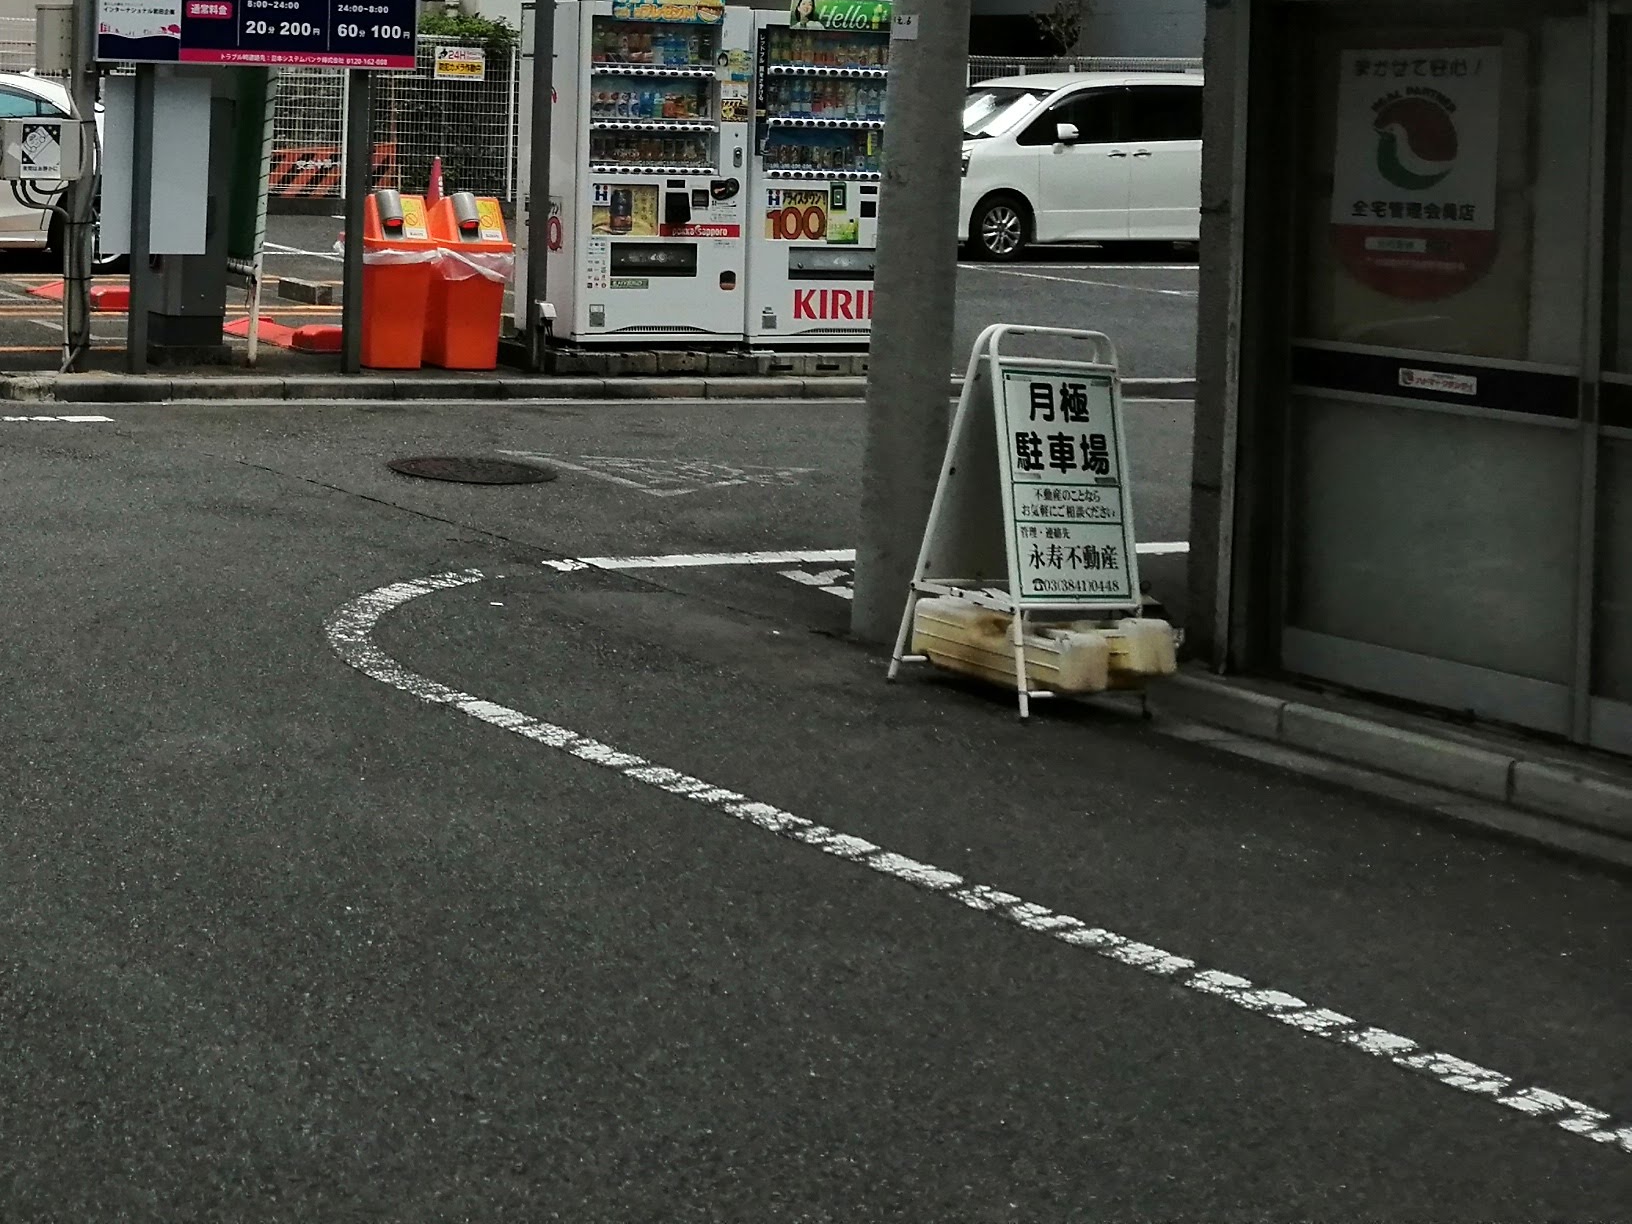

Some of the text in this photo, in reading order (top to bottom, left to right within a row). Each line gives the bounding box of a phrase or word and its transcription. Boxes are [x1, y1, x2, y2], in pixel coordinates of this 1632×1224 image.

[190, 3, 228, 16] 通常料金
[1028, 381, 1090, 423] 月極
[1015, 431, 1110, 475] 駐車場
[1035, 488, 1101, 503] 不動産のことなら
[1021, 503, 1116, 519] お気軽にご相談ください
[1028, 543, 1119, 570] 永寿不動産
